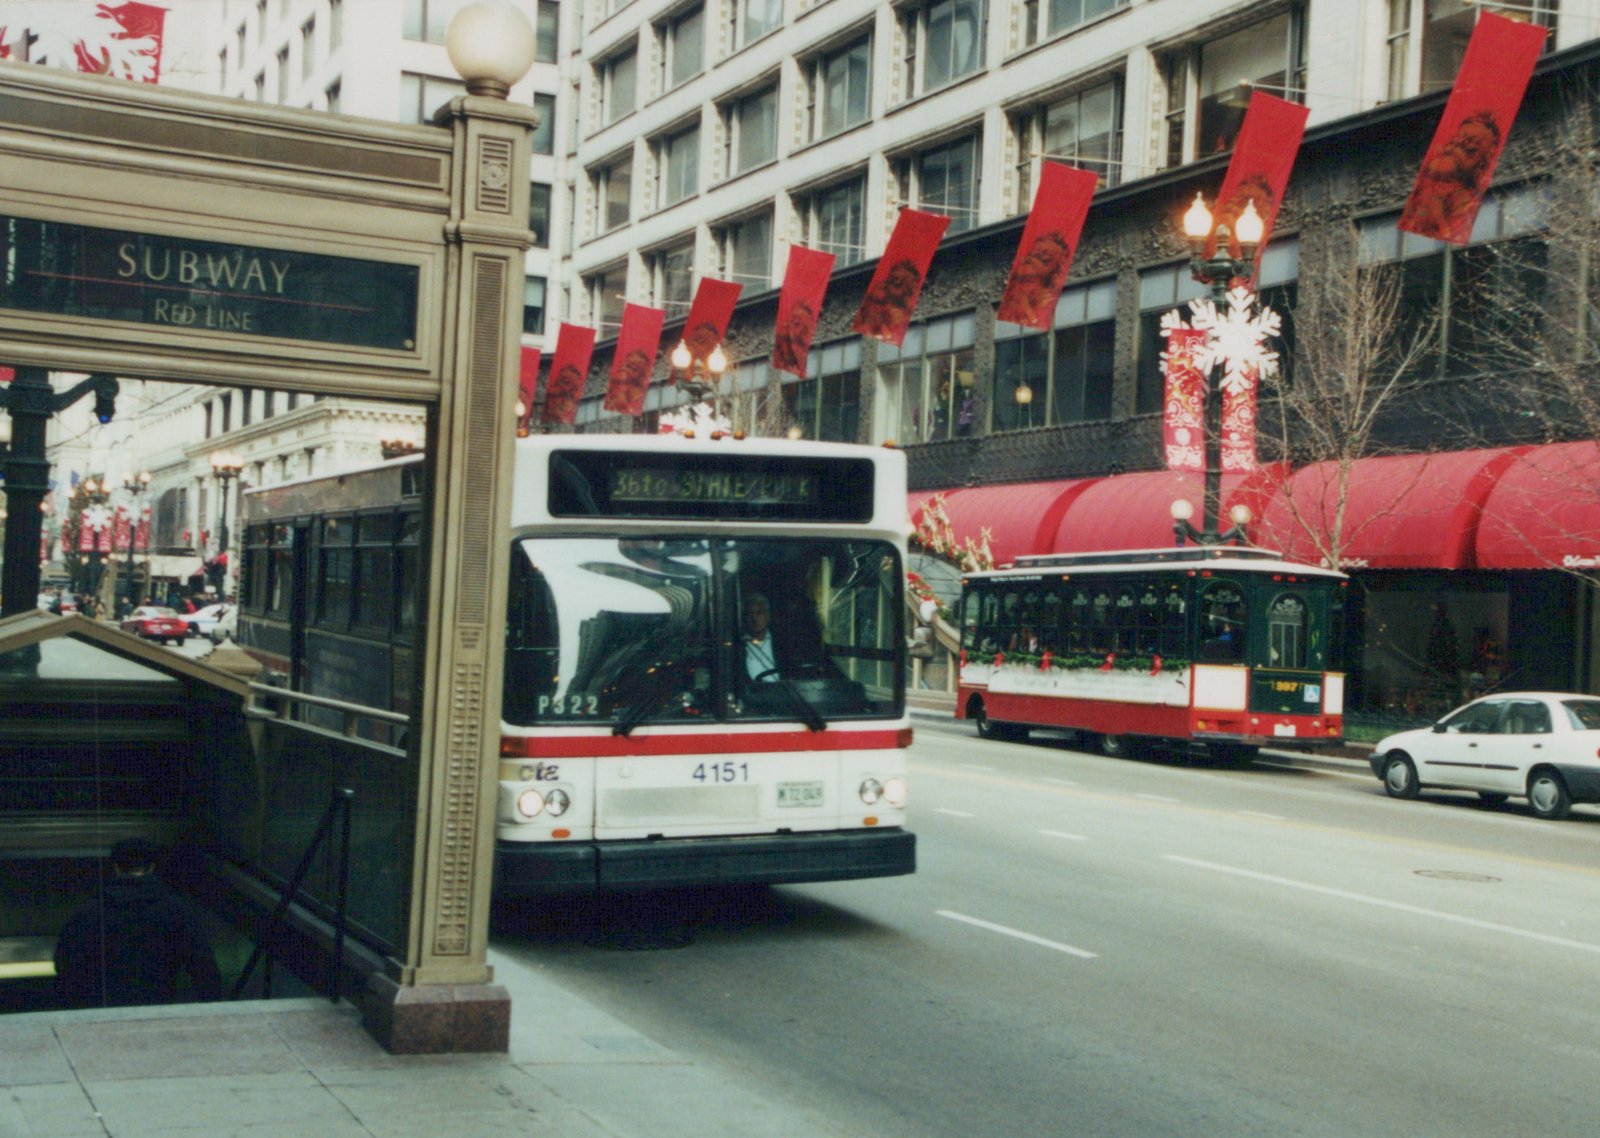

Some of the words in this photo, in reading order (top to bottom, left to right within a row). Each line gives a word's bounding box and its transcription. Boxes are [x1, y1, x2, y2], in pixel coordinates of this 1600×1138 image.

[118, 243, 290, 293] SUBWAY
[205, 303, 252, 331] LINE
[538, 695, 599, 715] P322
[692, 761, 749, 783] 4151
